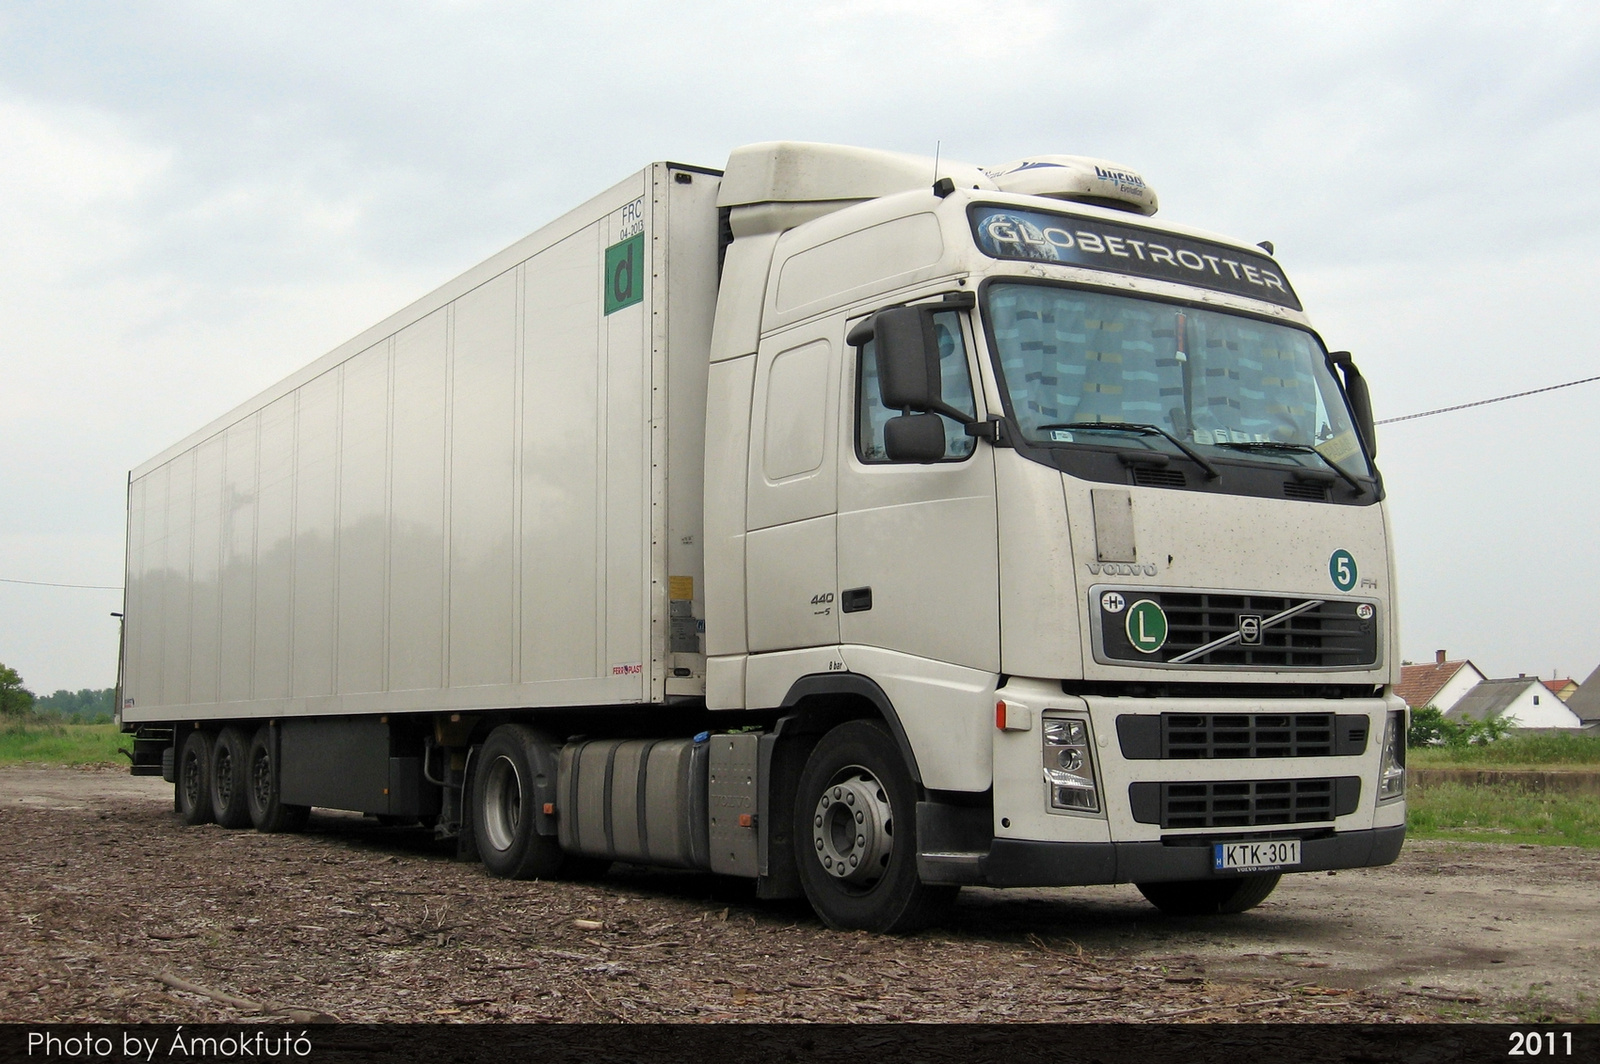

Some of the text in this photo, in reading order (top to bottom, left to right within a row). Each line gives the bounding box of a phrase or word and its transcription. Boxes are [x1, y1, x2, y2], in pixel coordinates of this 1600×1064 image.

[622, 199, 642, 226] FRC
[619, 219, 644, 241] 04-2013
[987, 221, 1288, 295] GLOBETROTTER
[613, 242, 633, 303] d
[1085, 562, 1158, 577] VOLVO
[1337, 557, 1351, 585] 5
[1360, 577, 1377, 589] FH
[810, 592, 834, 605] 440
[1109, 595, 1118, 609] H
[1138, 610, 1156, 643] L
[834, 661, 843, 670] bar
[1227, 843, 1296, 865] KTK-301
